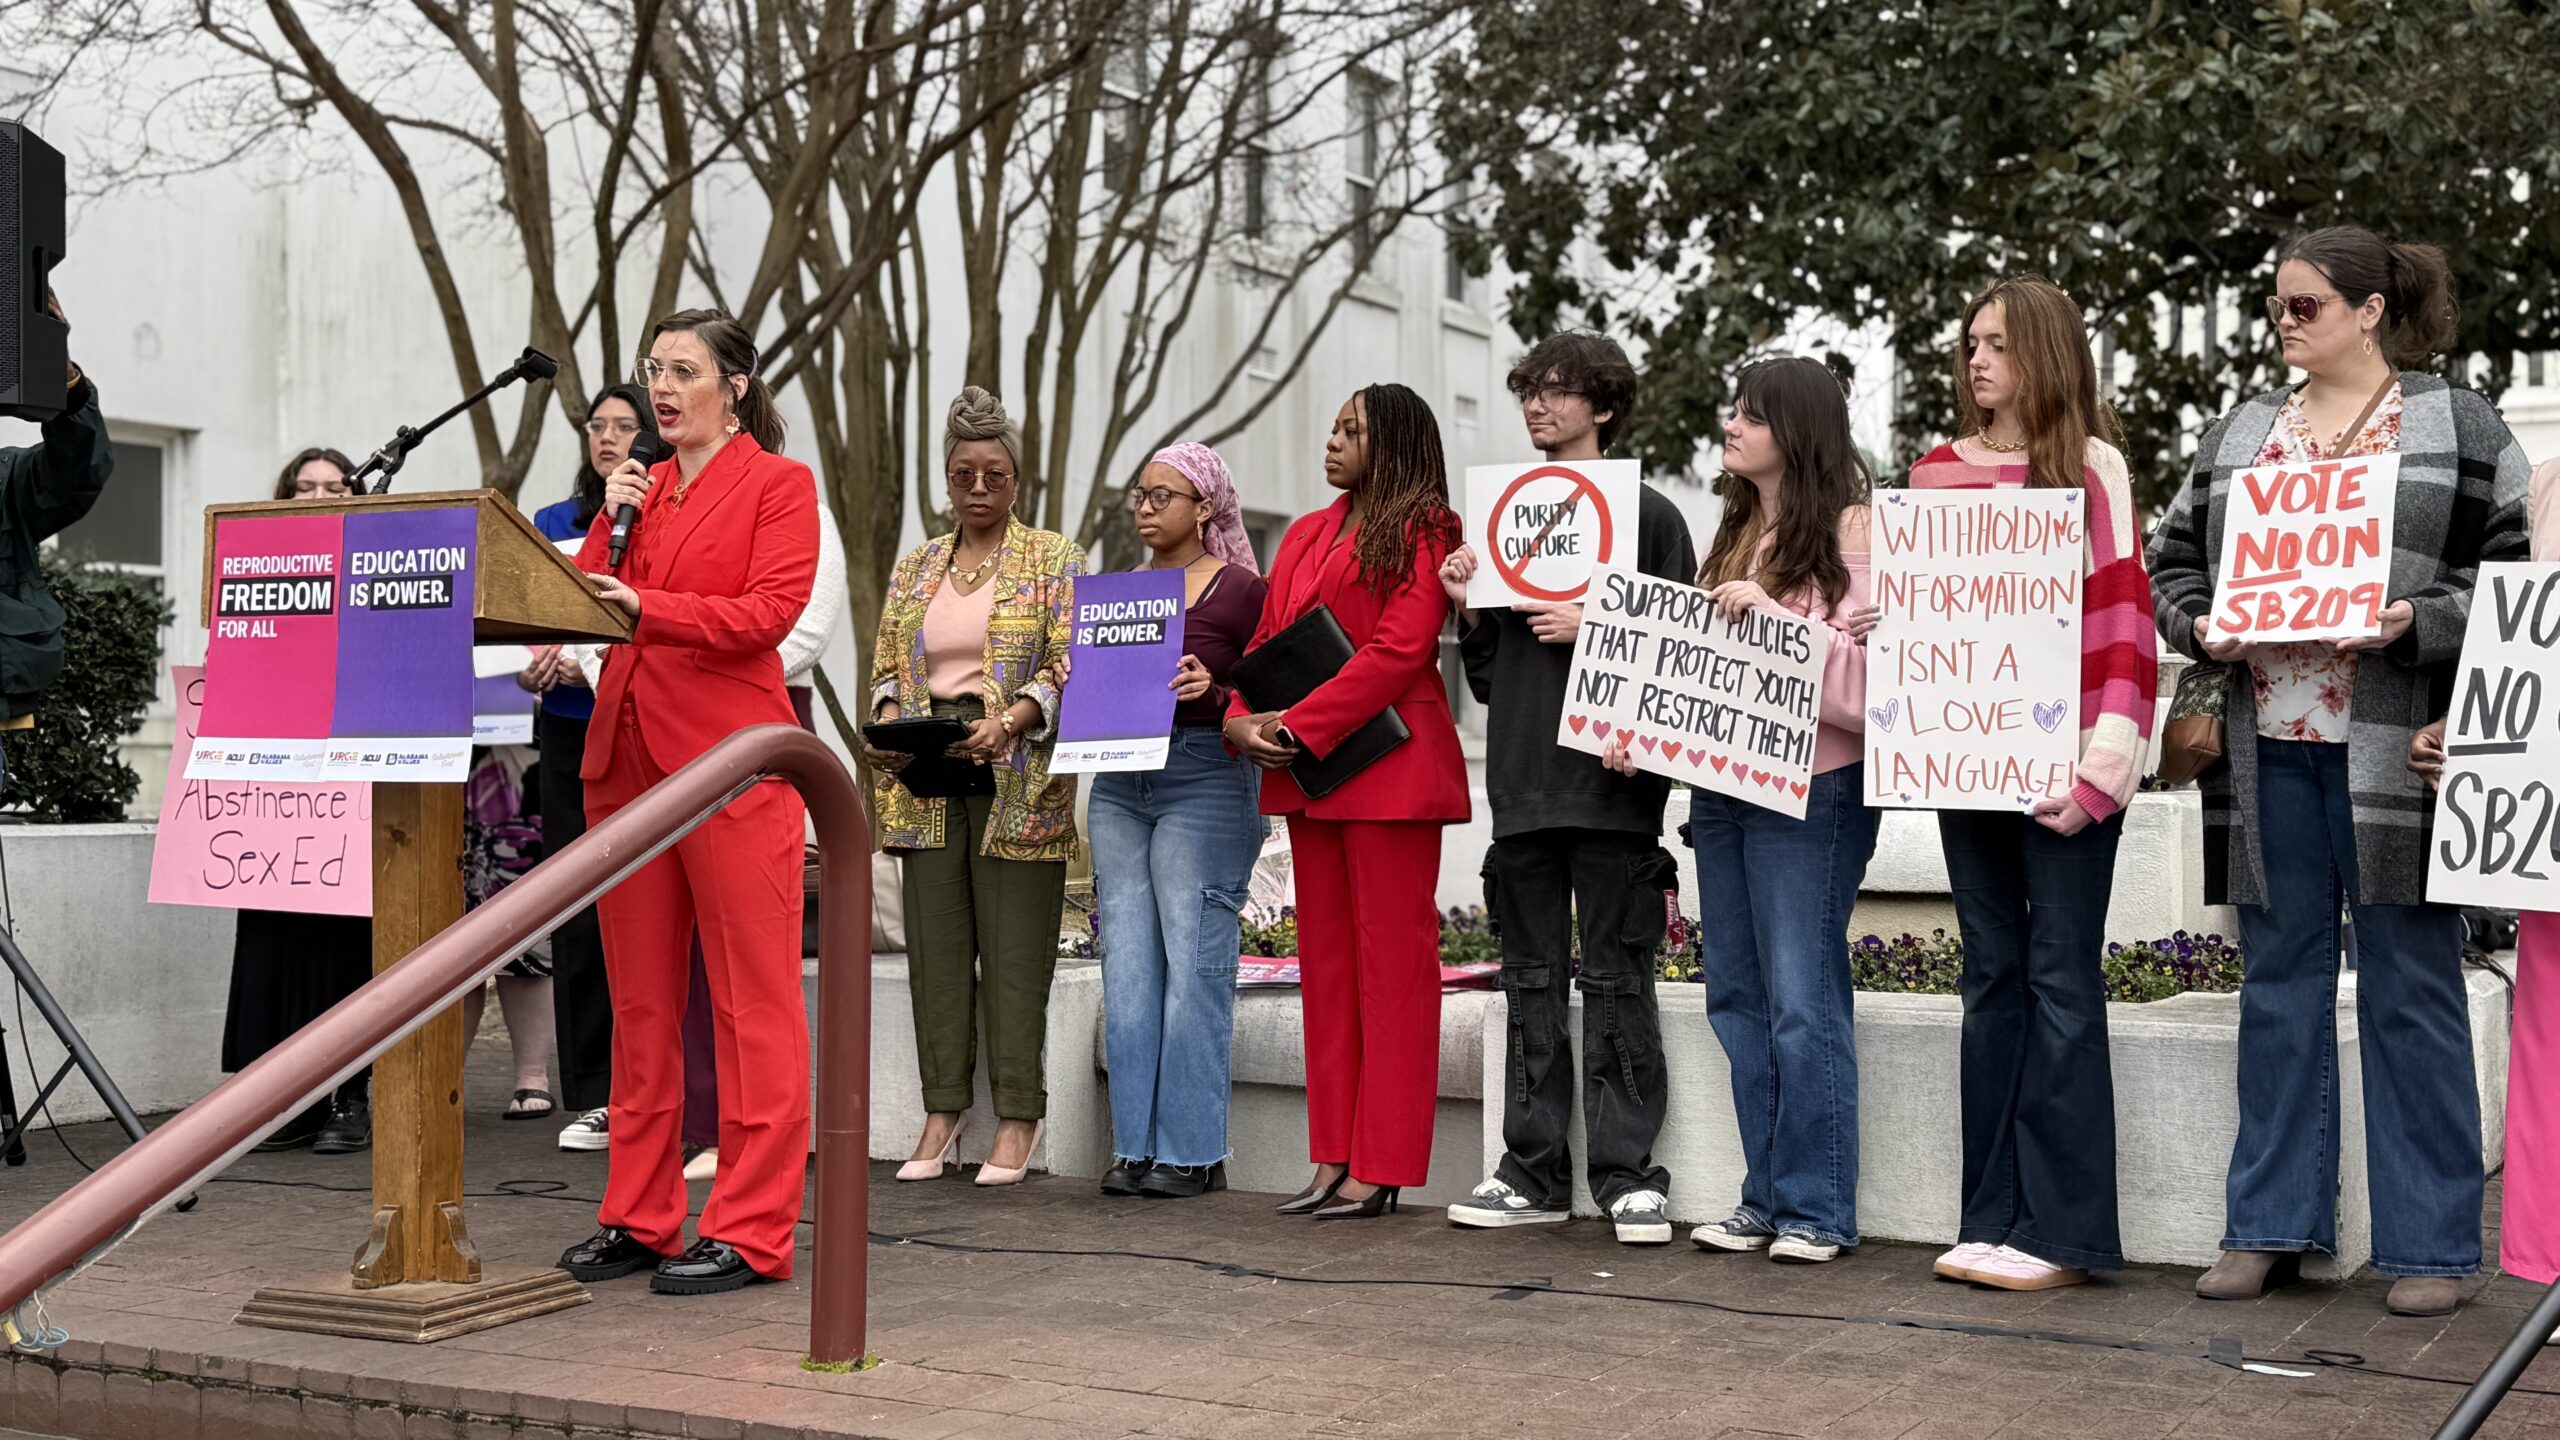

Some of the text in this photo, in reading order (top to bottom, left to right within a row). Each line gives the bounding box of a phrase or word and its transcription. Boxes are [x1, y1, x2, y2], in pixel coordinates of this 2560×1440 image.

[2242, 463, 2368, 515] VOTE
[1515, 501, 1577, 529] PURITY
[1879, 503, 2081, 558] WITHHOLDING
[222, 554, 333, 575] REPRODUCTIVE
[351, 547, 466, 575] EDUCATION
[1504, 533, 1581, 561] CULTURE
[2232, 518, 2379, 579] NO ON
[220, 581, 332, 612] FREEDOM
[349, 580, 450, 606] IS POWER.
[1079, 598, 1177, 623] EDUCATION
[1601, 573, 1718, 635] SUPPORT
[1877, 570, 2076, 622] INFORMATION
[2216, 582, 2385, 633] SB209
[217, 620, 278, 638] FOR ALL
[1077, 623, 1162, 646] IS POWER.
[1584, 620, 1817, 726] THAT PROTECT YOUTH,
[1993, 643, 2019, 682] A
[1575, 668, 1814, 773] NOT RESTRICT THEM!
[1907, 695, 2024, 736] LOVE
[2458, 666, 2541, 742] NO
[1874, 747, 2074, 799] LANGUAGE!
[174, 779, 347, 821] Abstinence
[203, 830, 347, 890] Sex Ed
